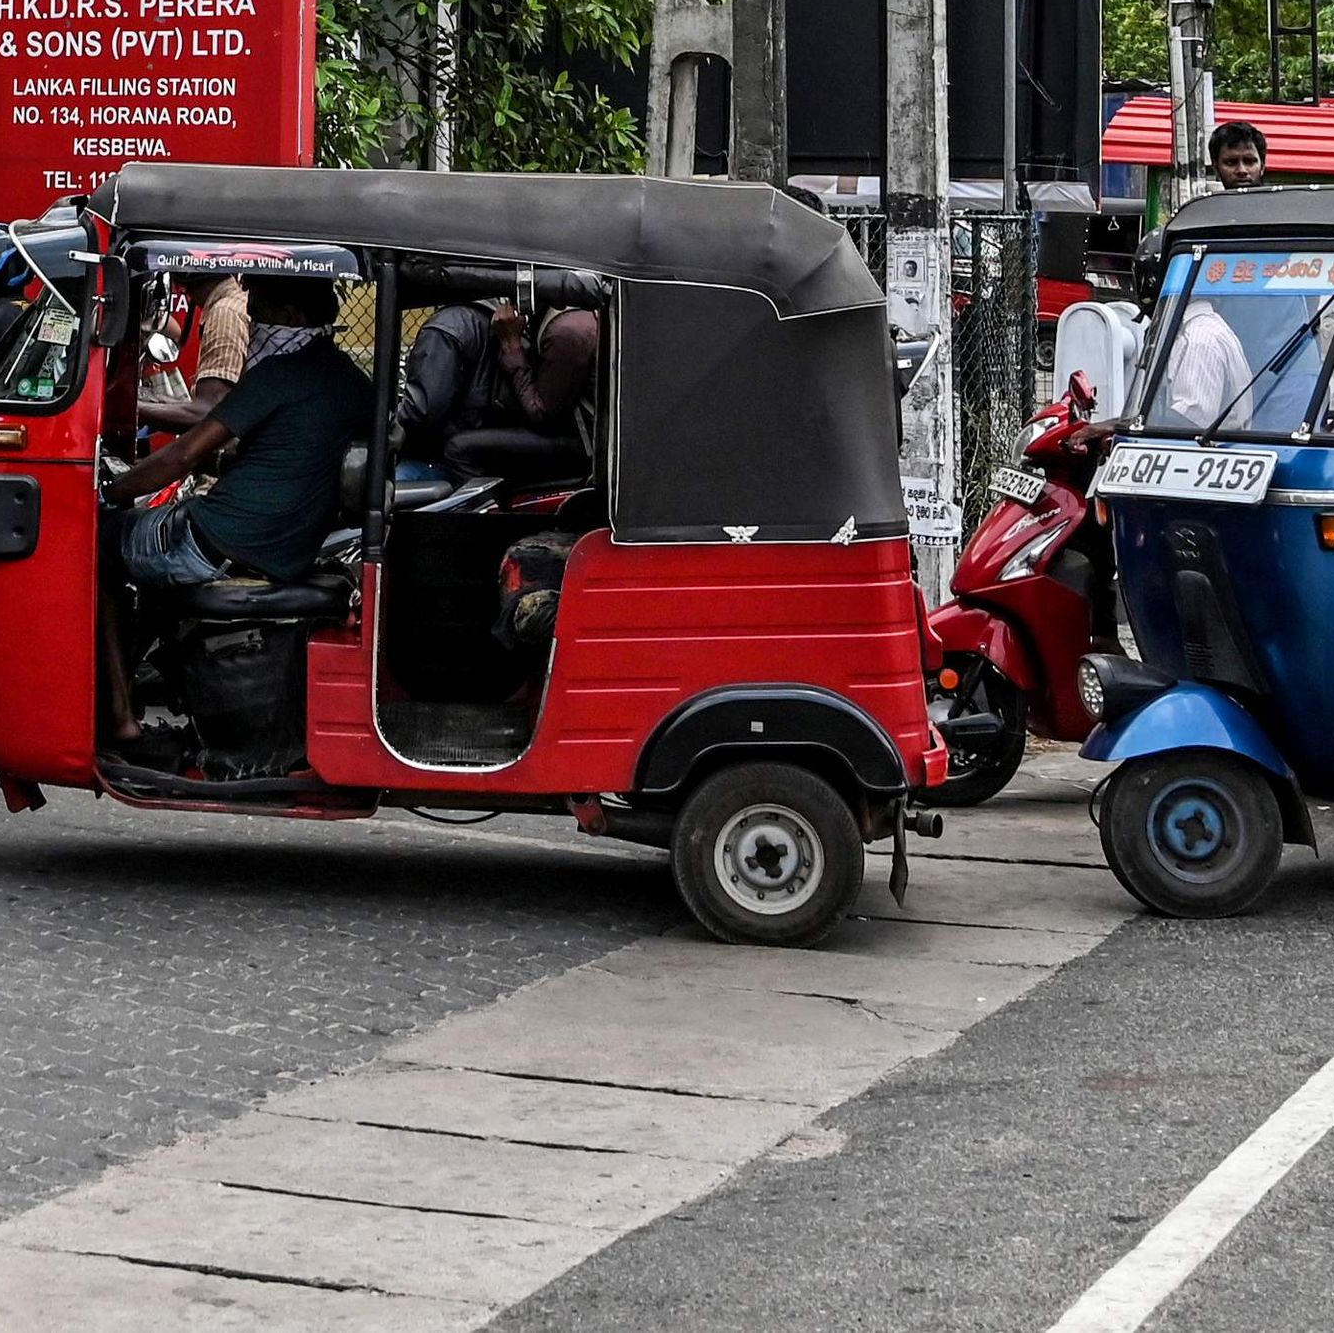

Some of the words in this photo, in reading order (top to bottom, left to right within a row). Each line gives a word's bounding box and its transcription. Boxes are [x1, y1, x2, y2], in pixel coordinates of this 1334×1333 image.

[0, 33, 19, 58] &
[26, 31, 103, 57] SONS
[111, 28, 184, 61] (PVT)
[191, 28, 252, 57] LTD.
[13, 78, 77, 97] LANKA
[80, 77, 152, 97] FILLING
[156, 77, 237, 97] STATION
[13, 106, 45, 126] NO.
[50, 106, 85, 128] 134,
[90, 106, 173, 126] HORANA
[176, 107, 237, 130] ROAD,
[73, 137, 172, 157] KESBEWA.
[43, 170, 83, 189] TEL:
[89, 170, 117, 189] 11
[157, 254, 180, 268] Quit
[257, 257, 282, 270] With
[283, 258, 301, 274] My
[1107, 465, 1130, 483] WP
[1131, 453, 1172, 485] QH
[1193, 457, 1266, 491] 9159
